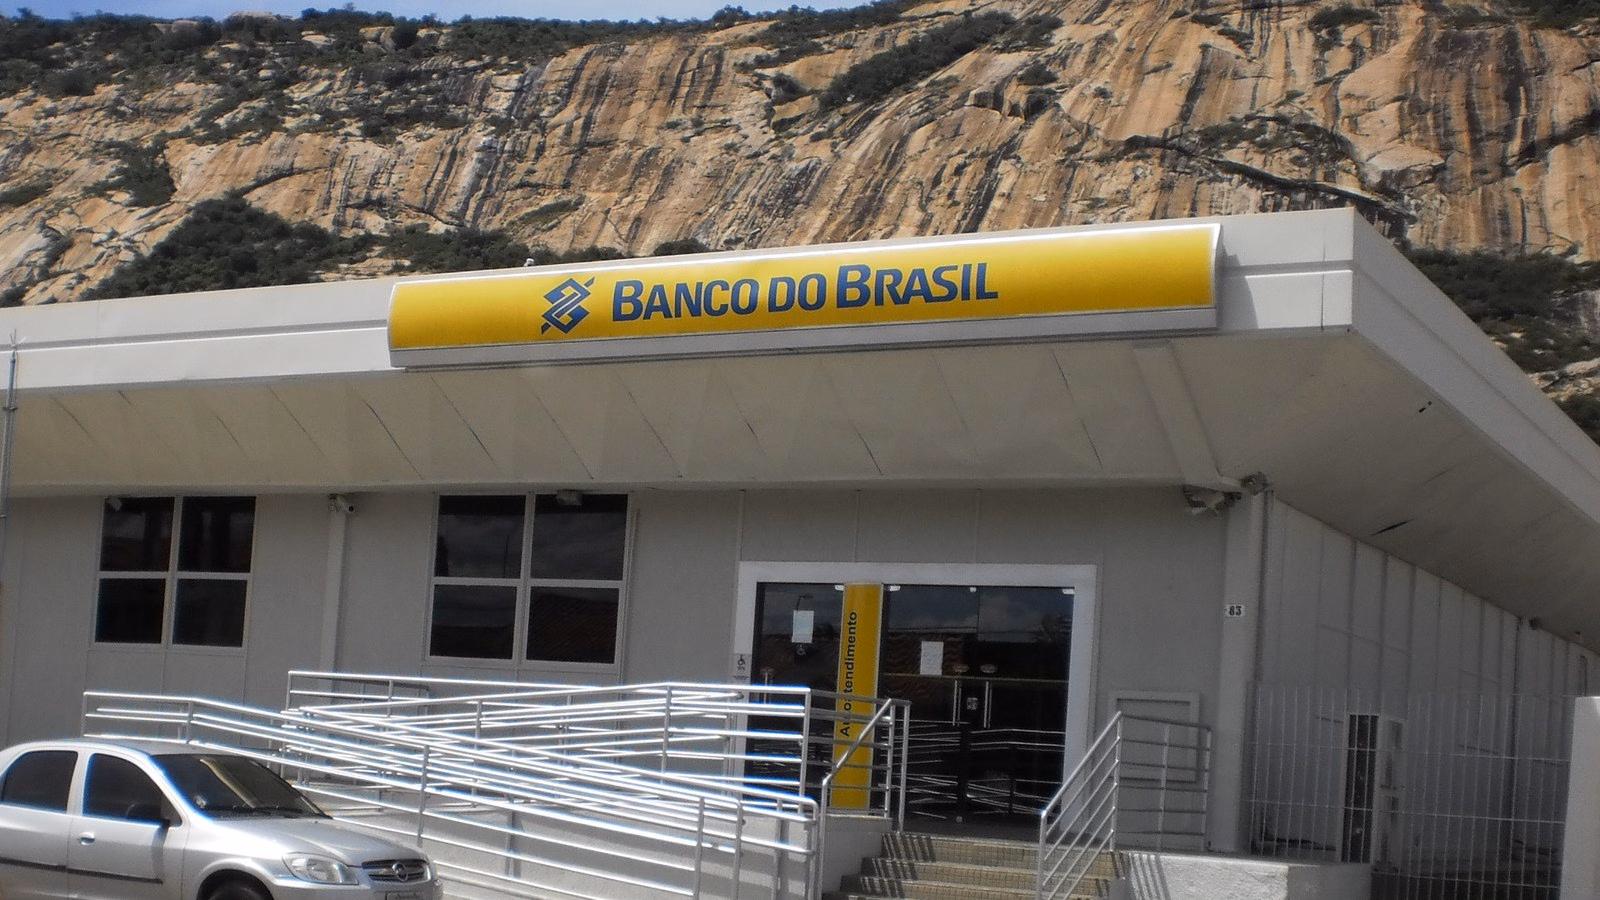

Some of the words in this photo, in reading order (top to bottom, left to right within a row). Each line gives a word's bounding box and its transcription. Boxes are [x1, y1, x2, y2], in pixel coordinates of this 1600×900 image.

[612, 278, 759, 321] BANCO
[768, 273, 827, 313] DO
[837, 262, 998, 308] BRASIL
[1229, 605, 1242, 616] 83
[840, 611, 858, 737] Aotendimento
